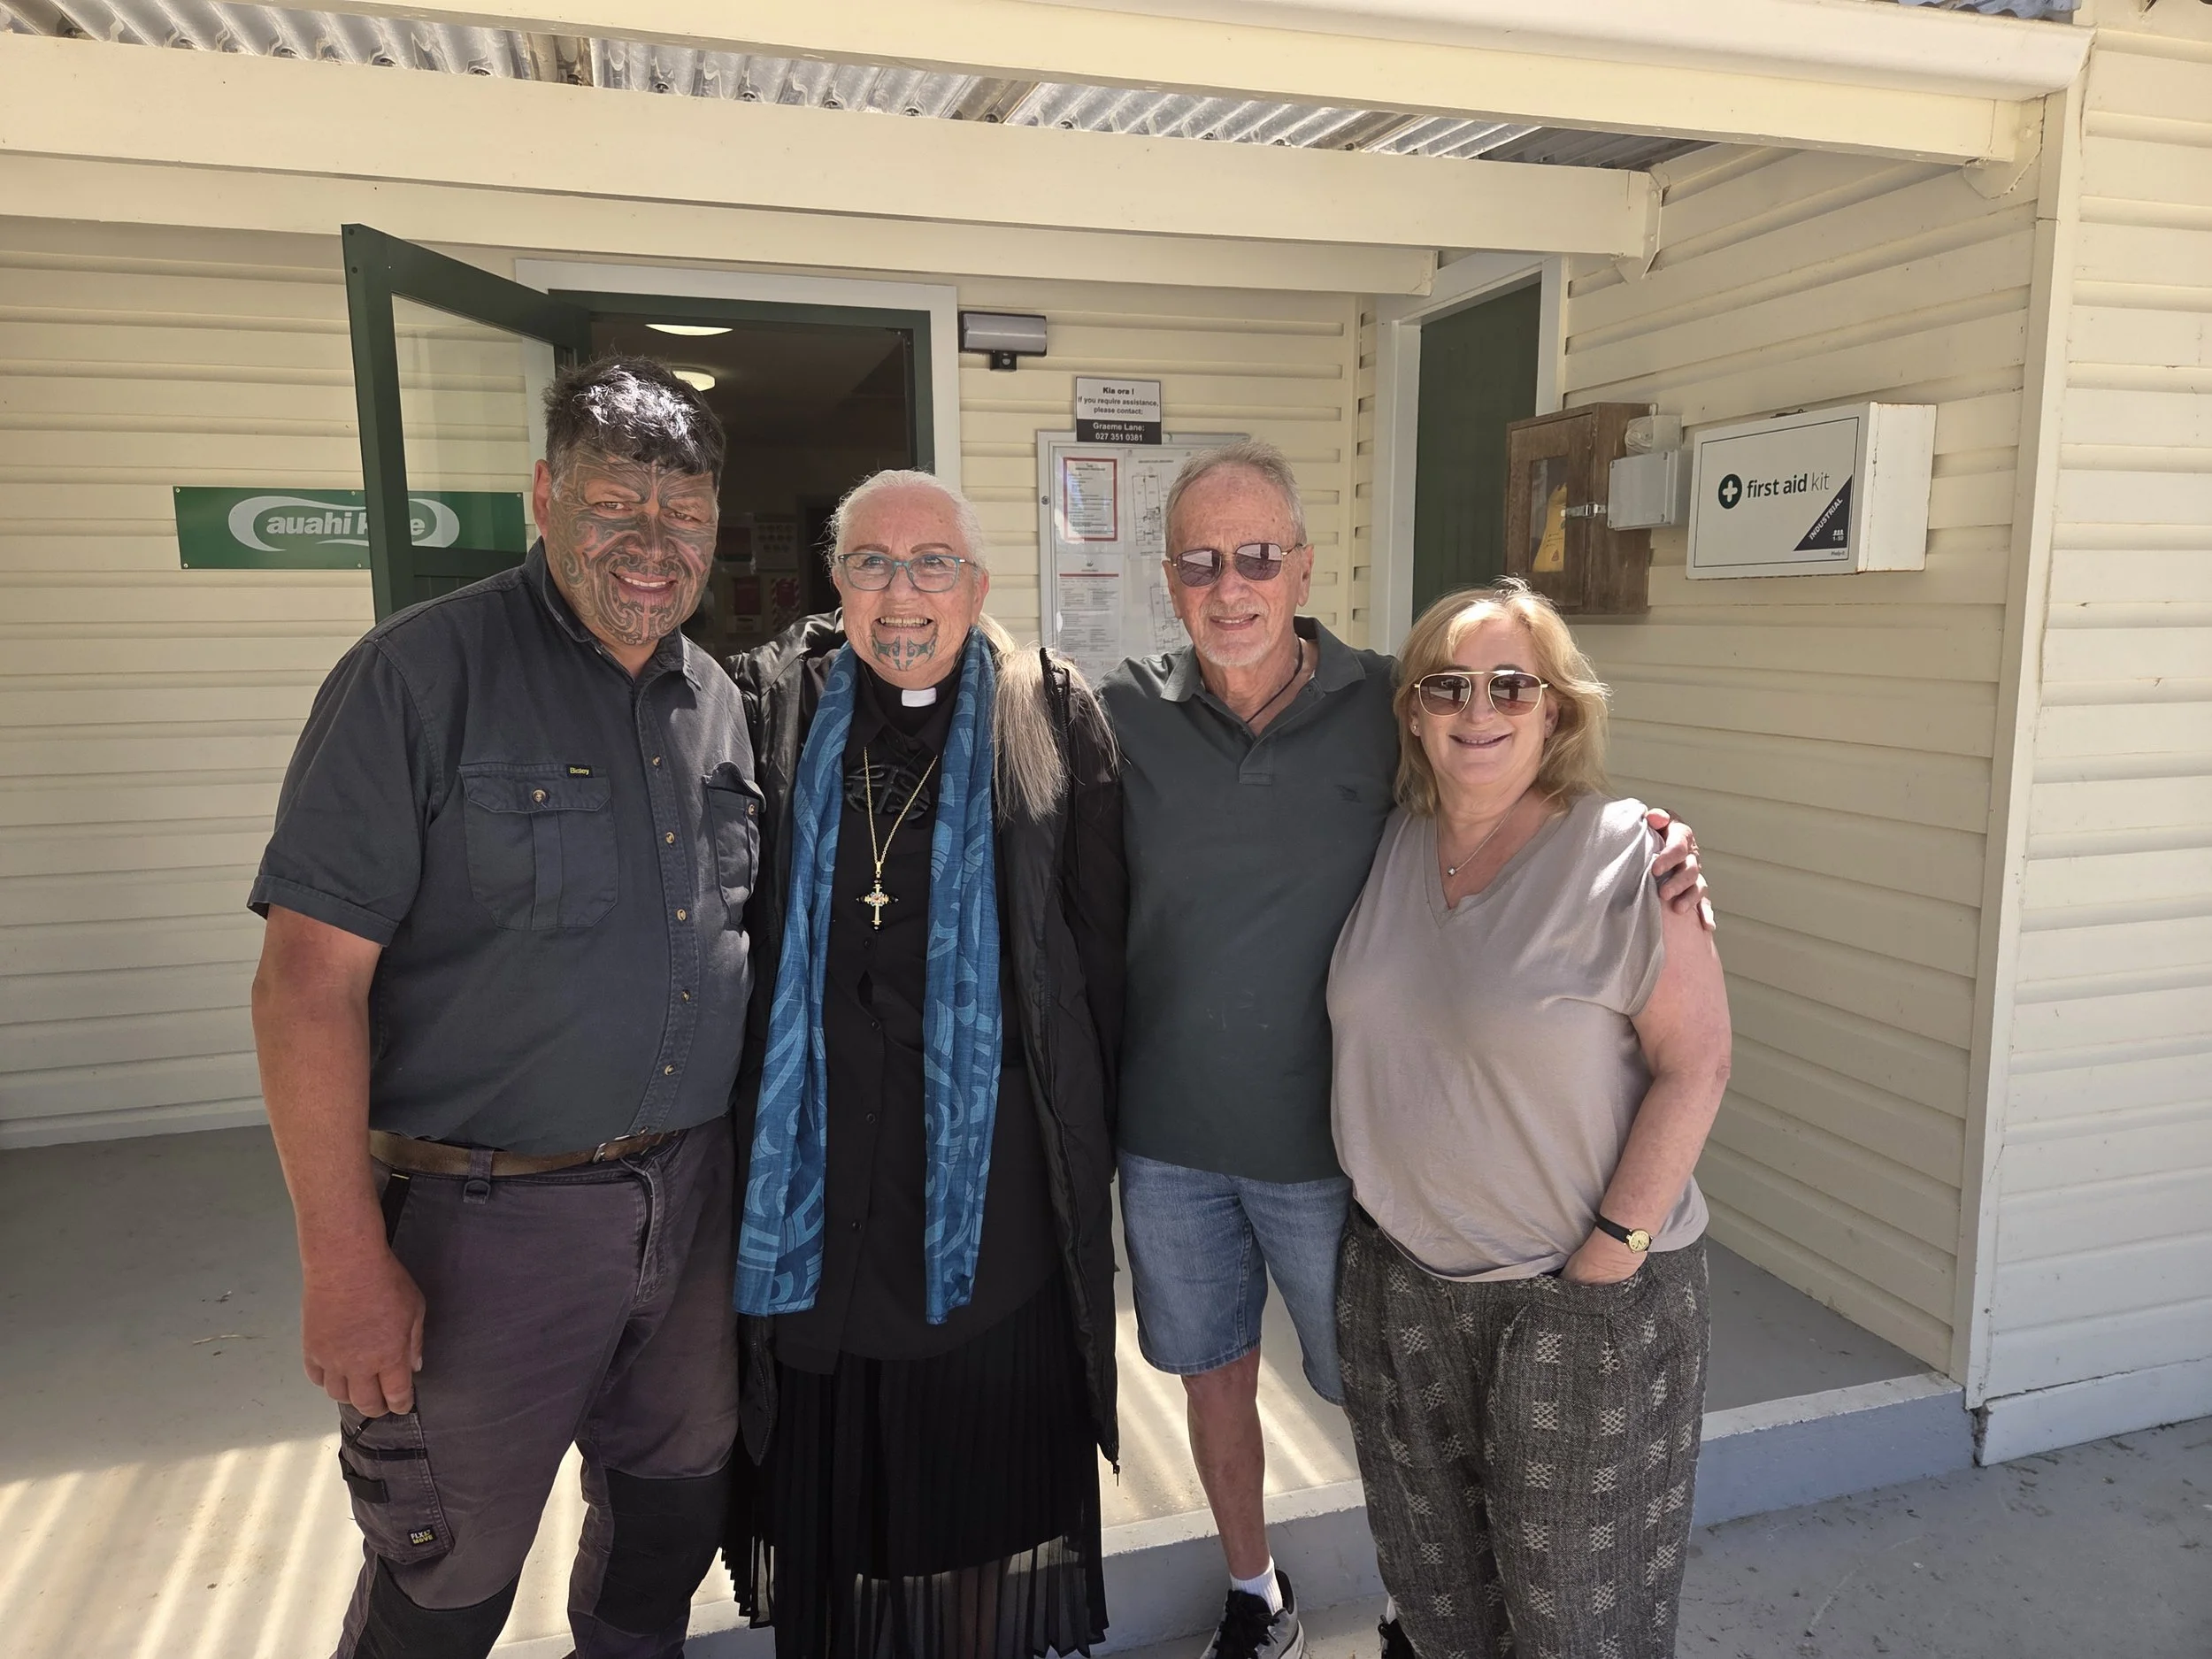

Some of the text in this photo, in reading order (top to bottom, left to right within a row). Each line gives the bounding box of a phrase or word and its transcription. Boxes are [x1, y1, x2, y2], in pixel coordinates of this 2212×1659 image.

[1747, 472, 1830, 498] first aid kit
[266, 511, 353, 535] auahi
[1809, 497, 1843, 541] INDUSTRIAL
[411, 1531, 424, 1540] FLX
[412, 1534, 434, 1544] MOVE
